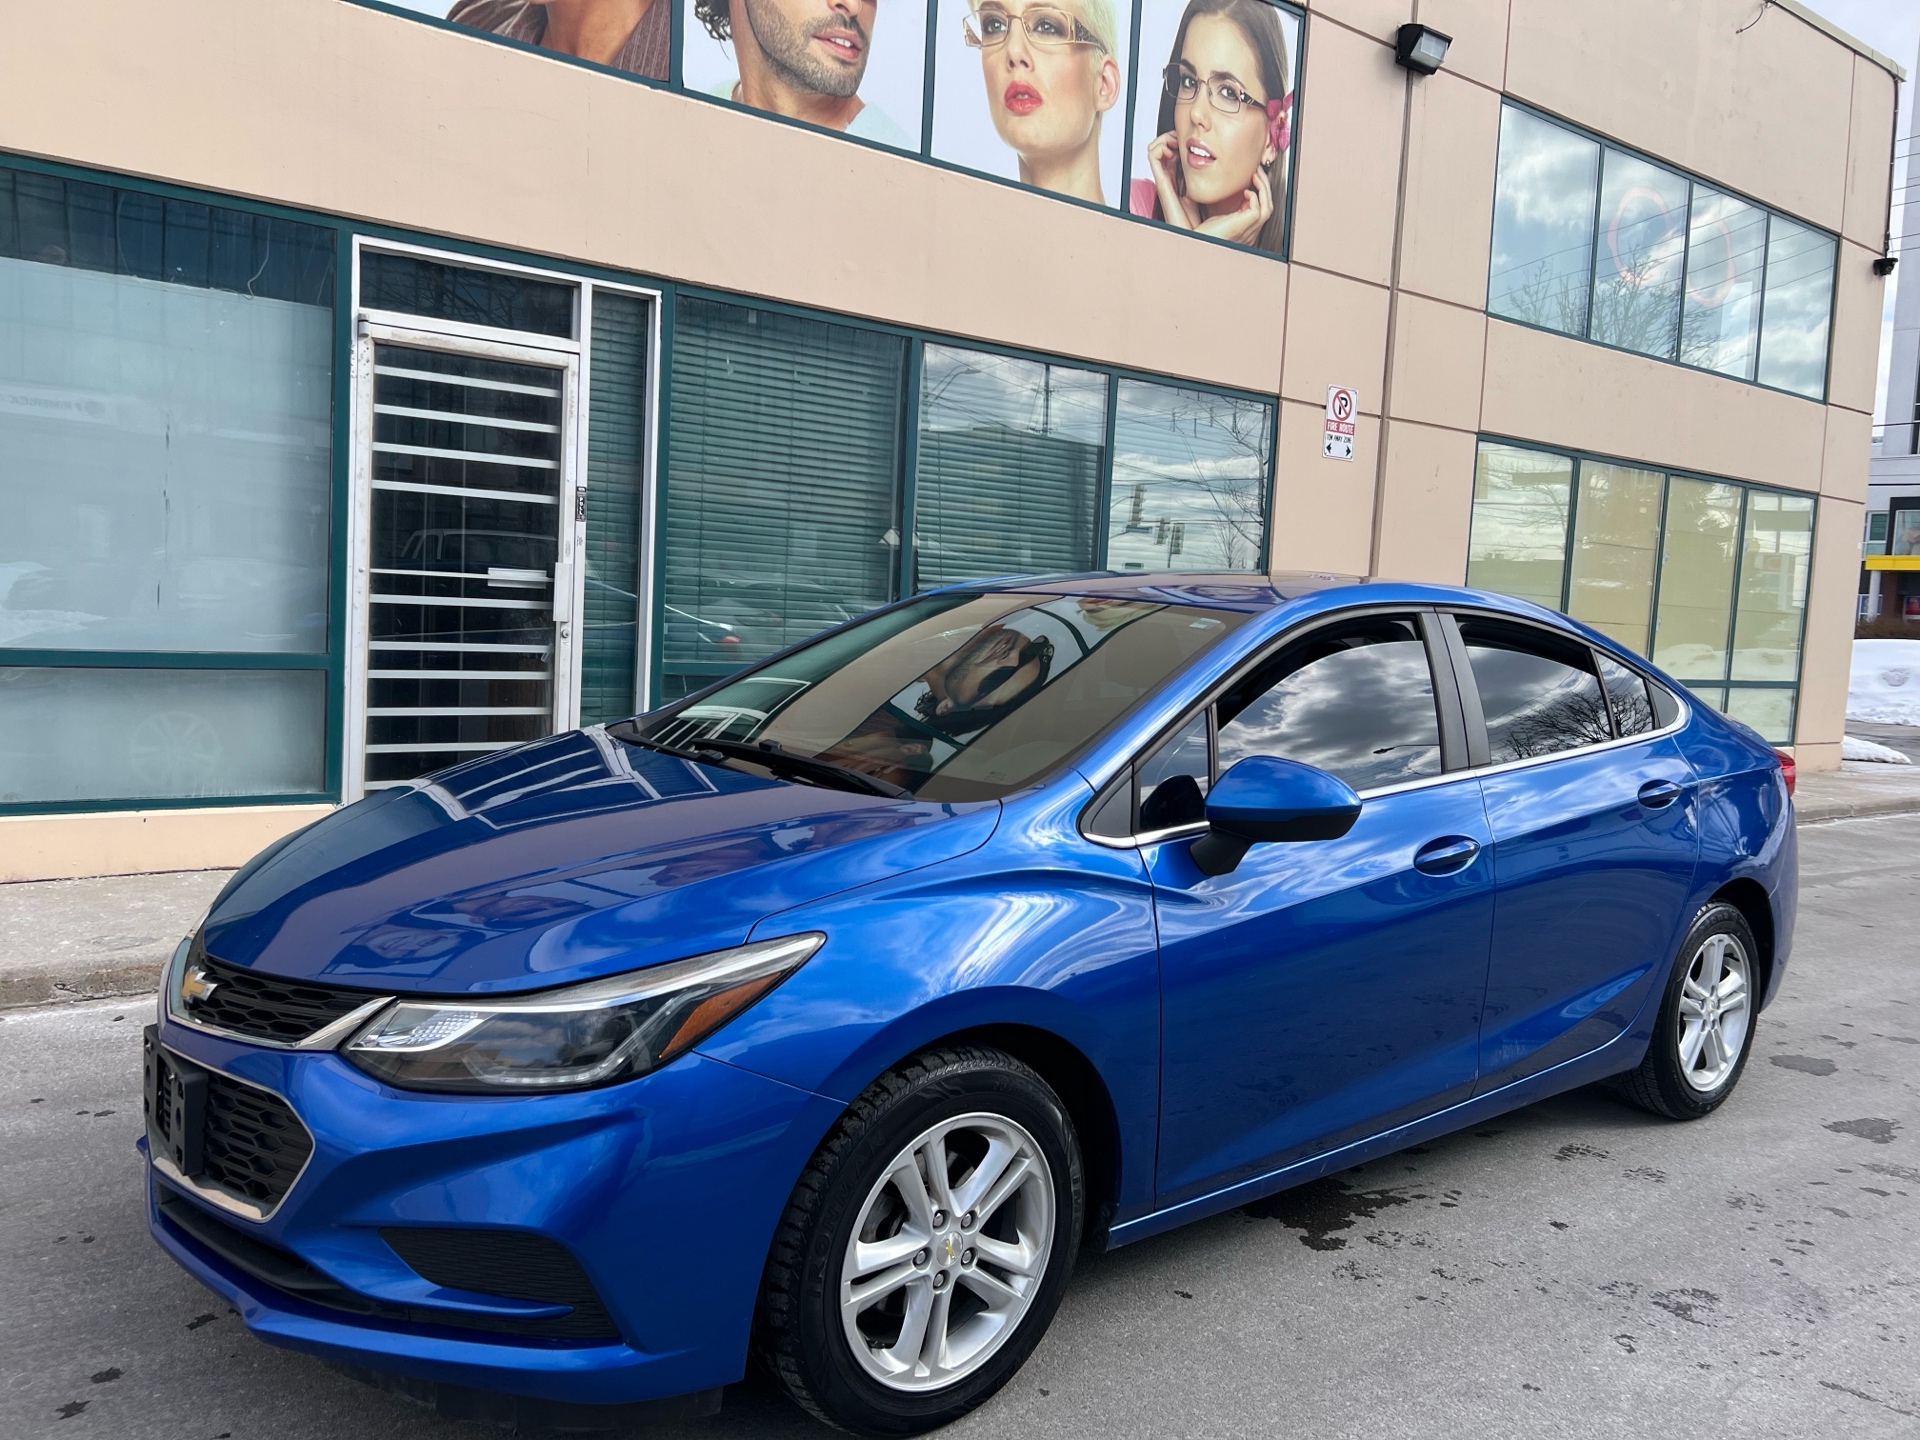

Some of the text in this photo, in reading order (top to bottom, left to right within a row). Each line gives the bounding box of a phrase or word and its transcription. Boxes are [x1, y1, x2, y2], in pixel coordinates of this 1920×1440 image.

[1327, 421, 1354, 435] FIRE ROUTE
[1343, 436, 1352, 444] ZONE
[806, 1127, 887, 1300] IRONMAN
